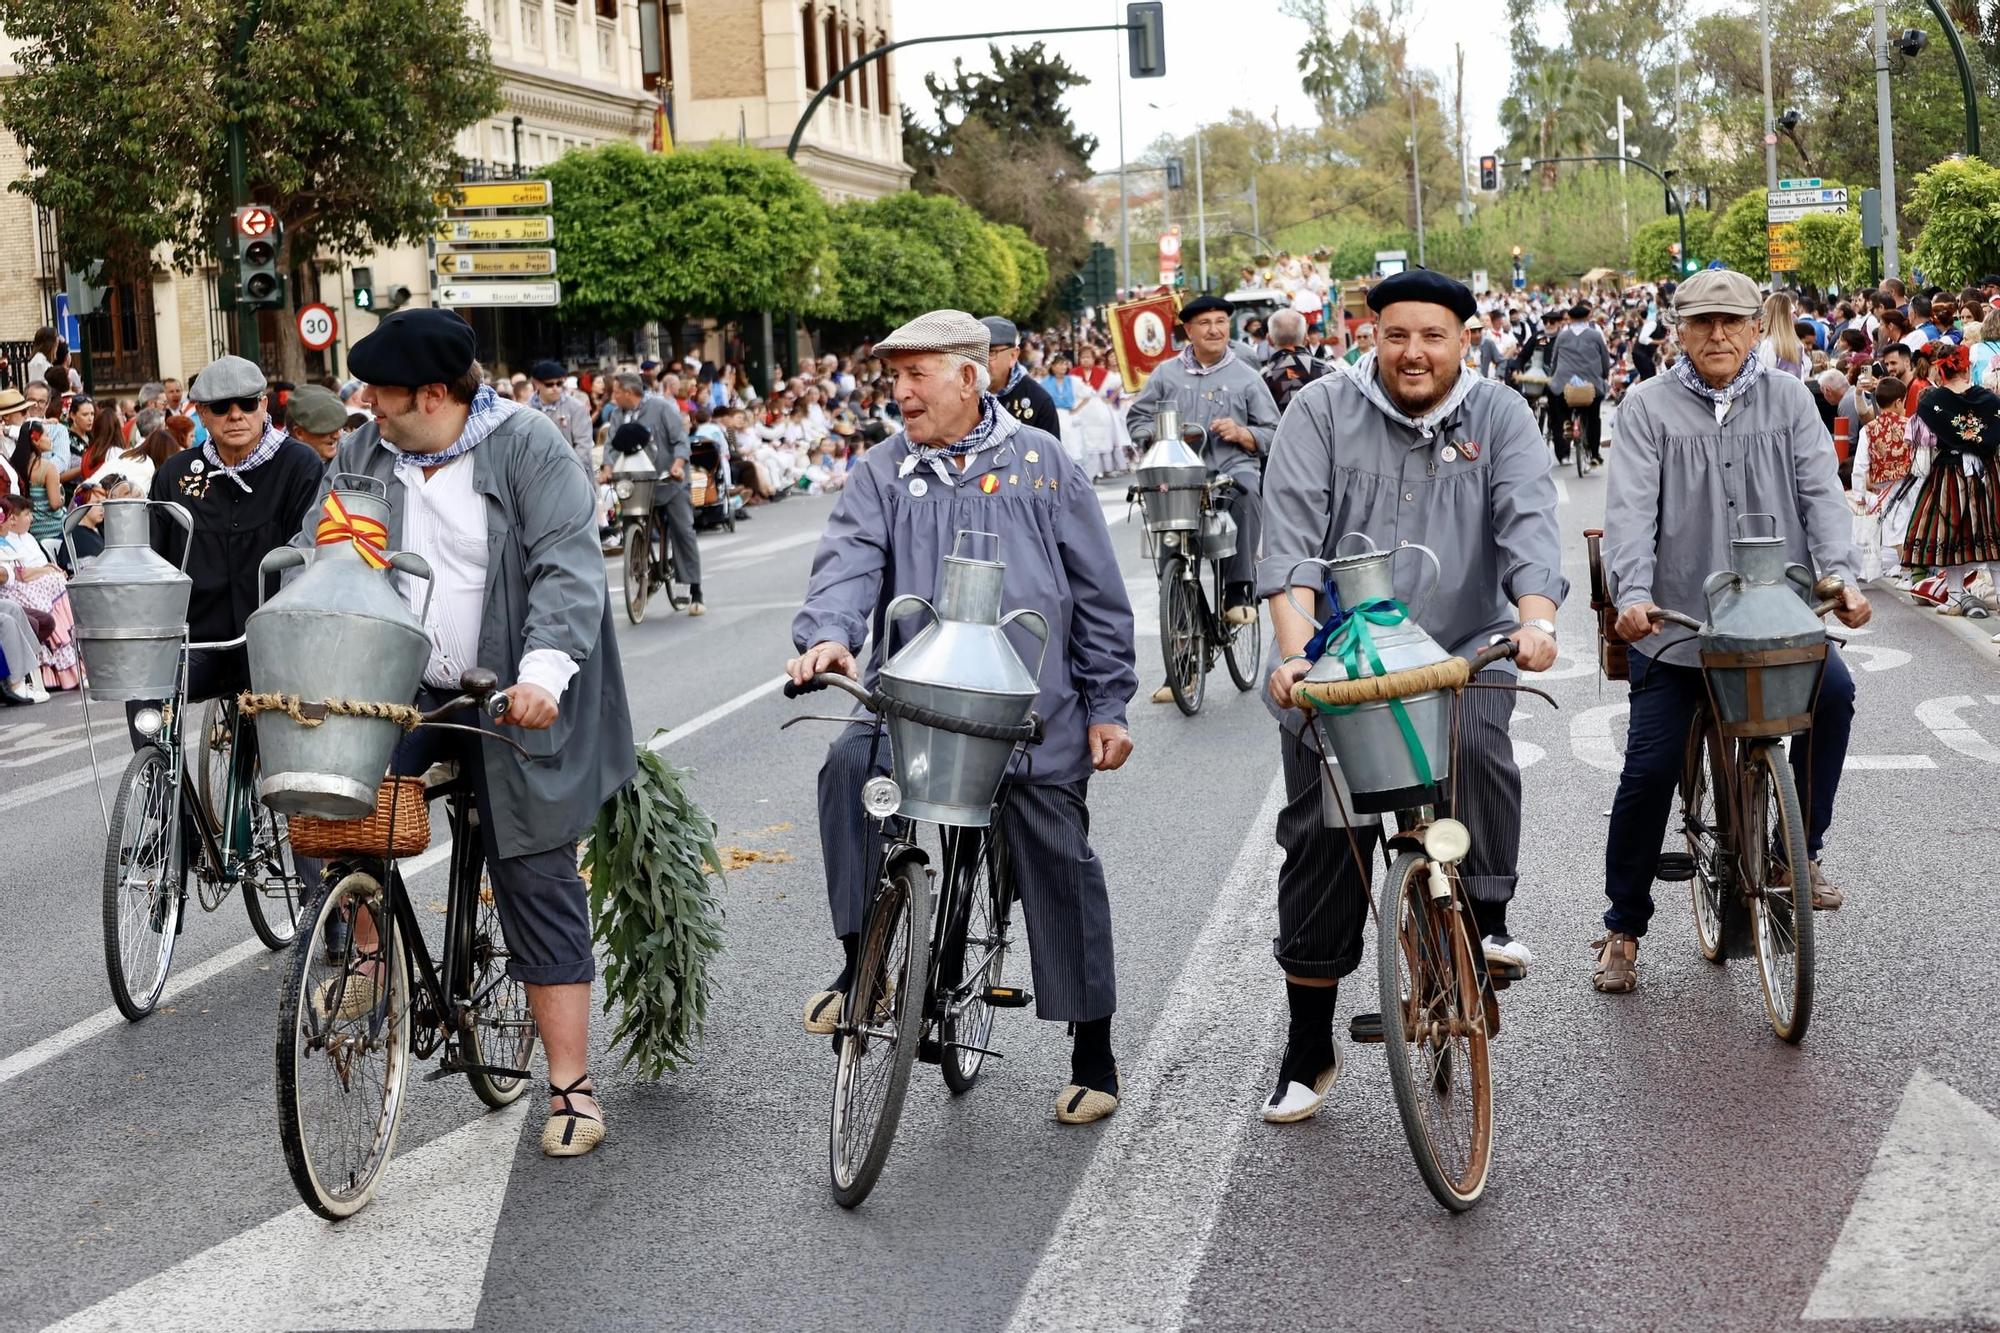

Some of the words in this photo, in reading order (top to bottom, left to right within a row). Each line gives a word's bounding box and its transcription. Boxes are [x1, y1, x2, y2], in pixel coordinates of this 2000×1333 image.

[512, 194, 544, 203] Cetina
[472, 230, 498, 239] Arco
[521, 229, 544, 238] Juan
[509, 262, 521, 270] de
[525, 261, 547, 271] Pepe
[523, 292, 554, 301] Murcia
[306, 319, 328, 334] 30
